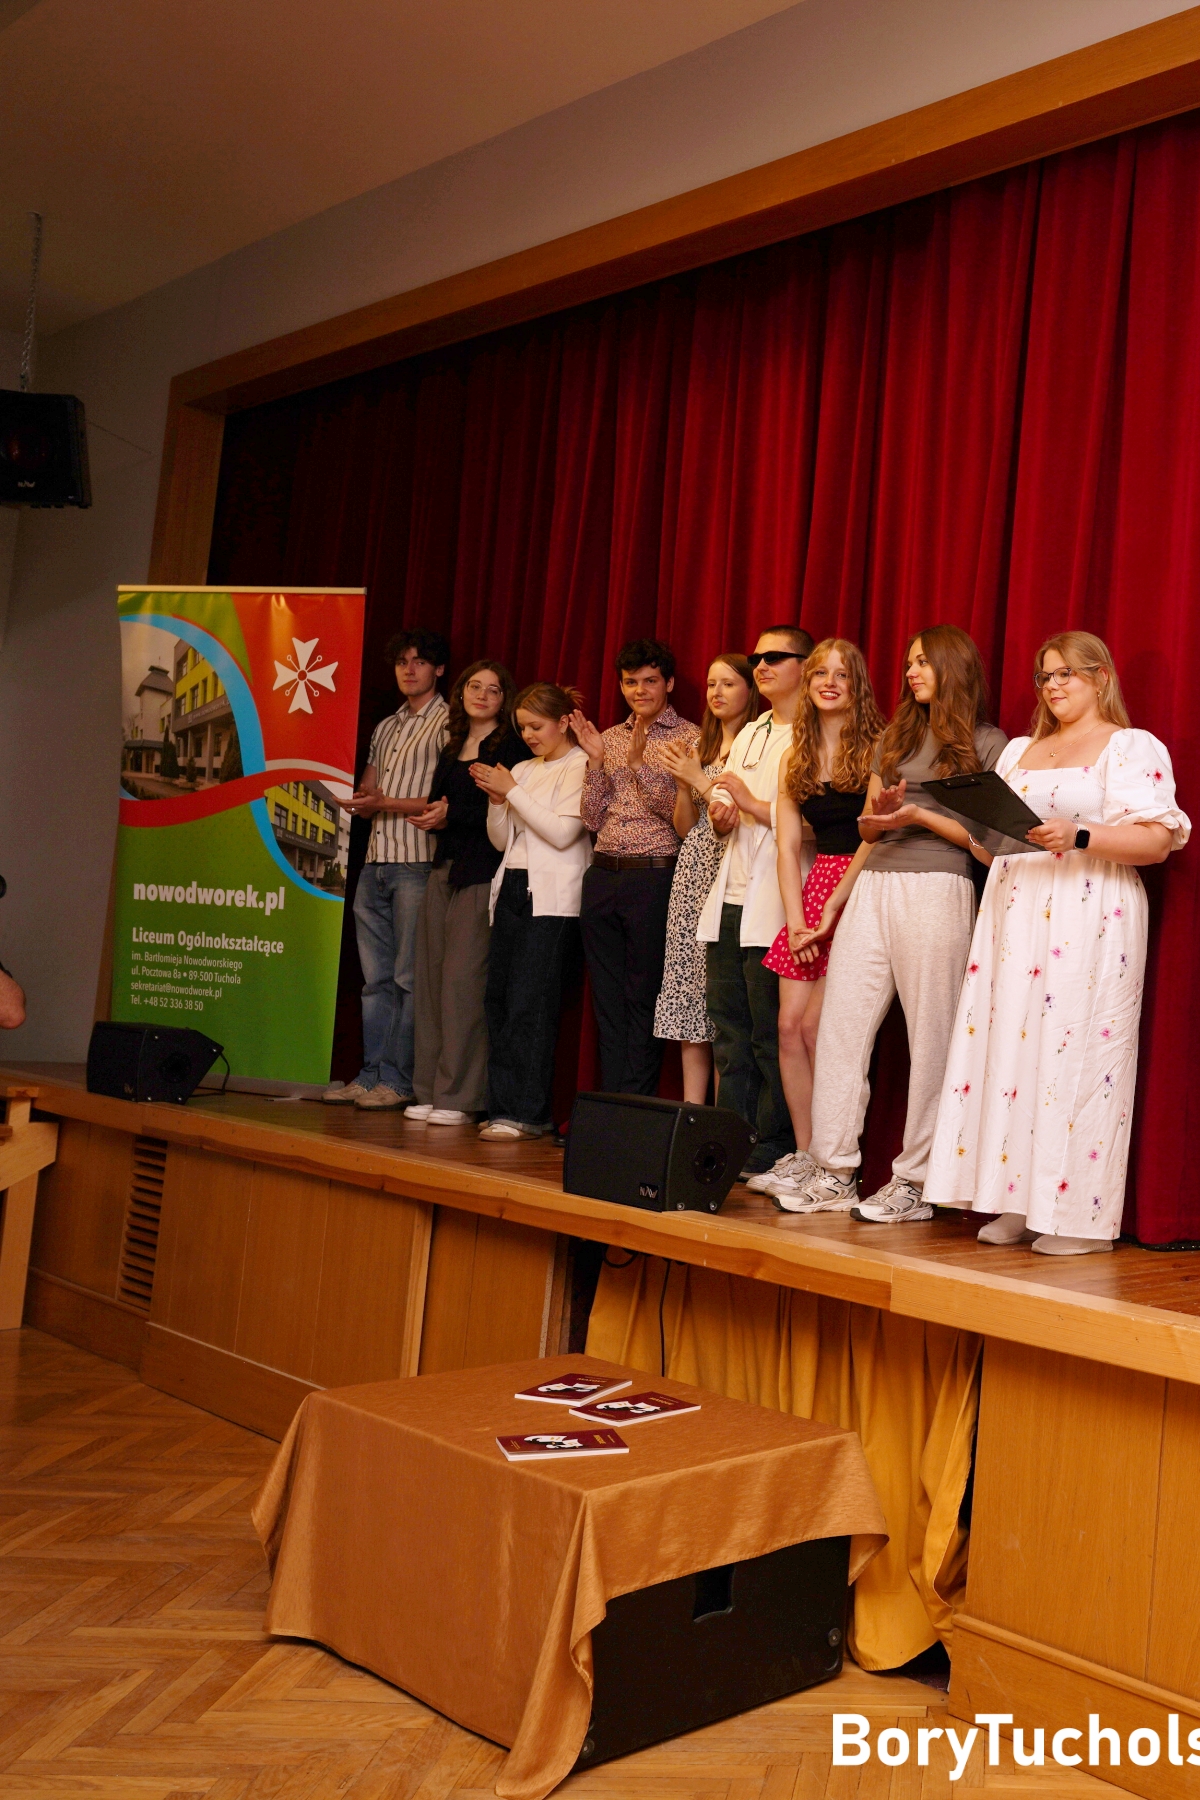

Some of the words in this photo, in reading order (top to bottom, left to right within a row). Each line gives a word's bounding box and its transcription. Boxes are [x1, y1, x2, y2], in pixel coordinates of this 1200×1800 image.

[133, 881, 285, 916] nowodworek.pl
[132, 927, 175, 945] Liceum
[177, 930, 284, 957] Ogólnokształcące
[131, 951, 143, 960] im.
[144, 951, 182, 967] Bartłomieja
[183, 955, 243, 972] Nowodworskiego
[131, 965, 141, 976] ul.
[141, 966, 172, 978] Pocztowa
[173, 968, 182, 979] 8a
[188, 970, 214, 982] 89-500
[214, 972, 241, 985] Tuchola
[130, 980, 223, 1000] sekretariat@nowodworek.pl
[130, 994, 142, 1005] Tel.
[143, 996, 158, 1007] +48
[159, 997, 168, 1008] 52
[169, 998, 183, 1009] 336
[184, 999, 193, 1010] 38
[194, 1000, 204, 1011] 50
